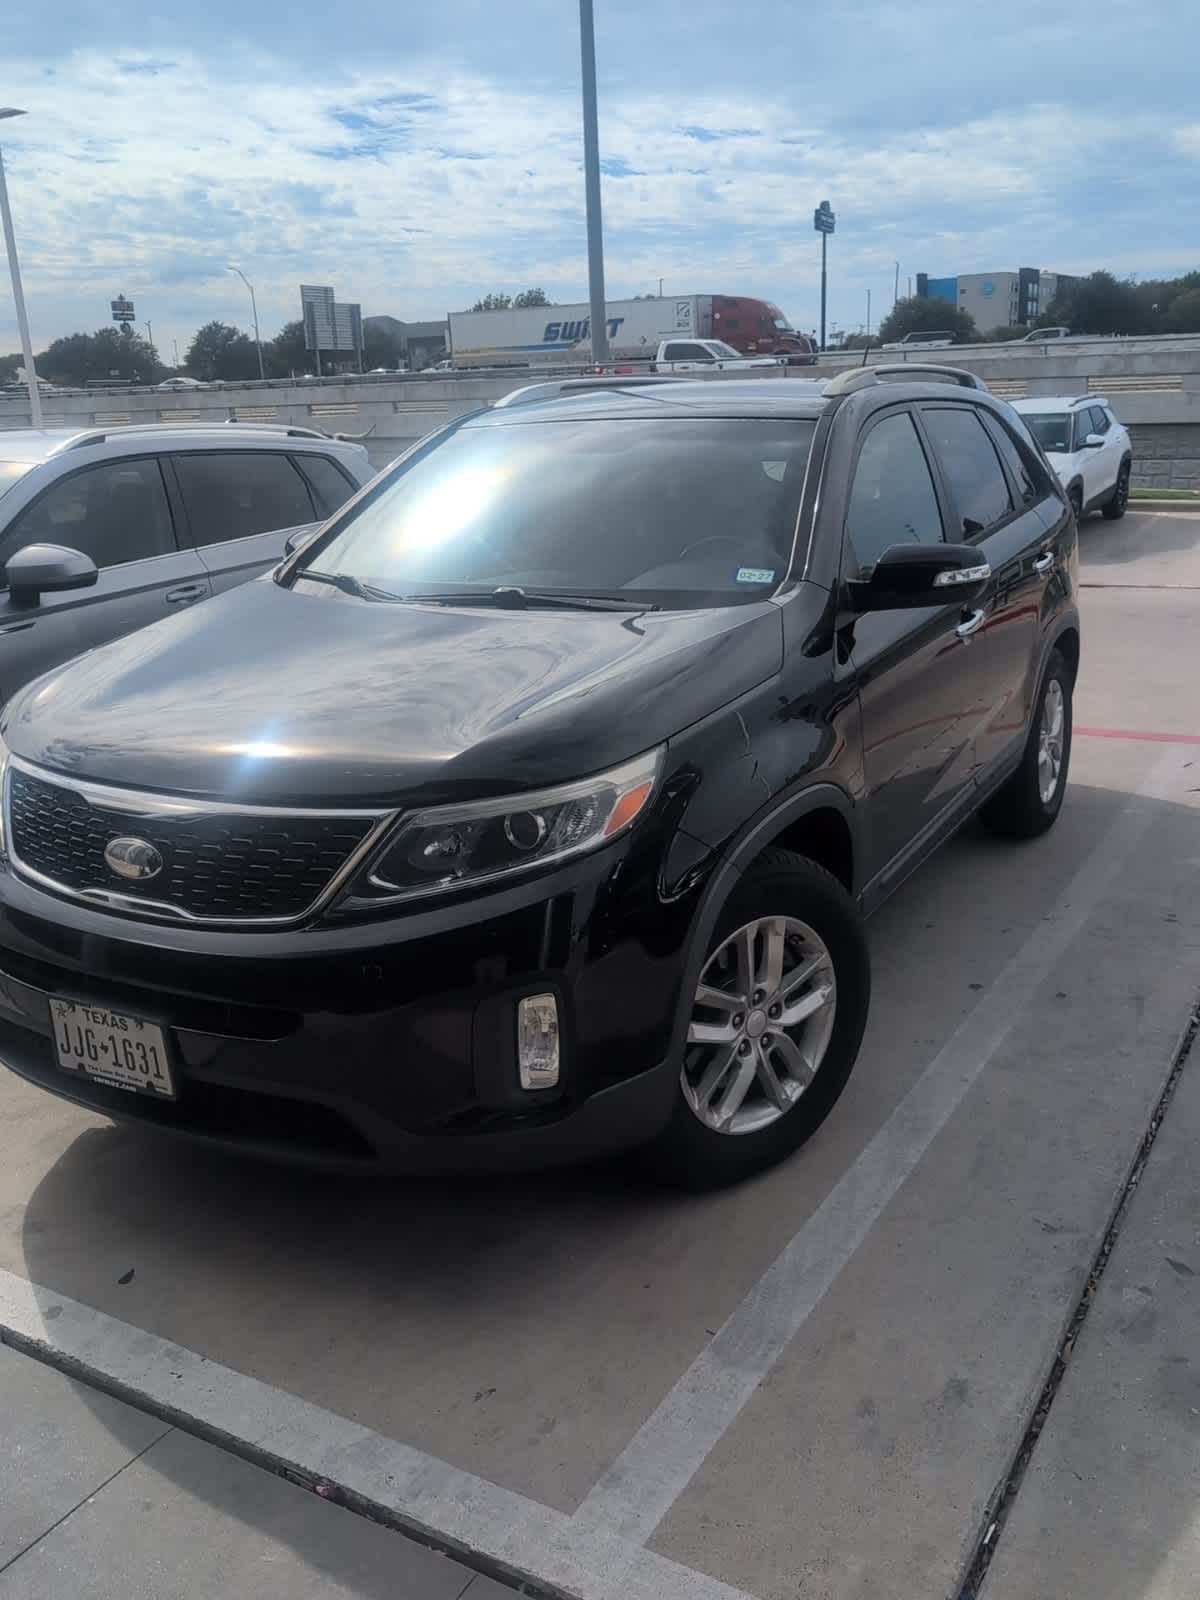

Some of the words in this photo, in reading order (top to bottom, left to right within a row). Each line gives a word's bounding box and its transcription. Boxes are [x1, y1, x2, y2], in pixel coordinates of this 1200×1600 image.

[543, 317, 625, 341] SWIT
[82, 1008, 128, 1032] TEXAS
[60, 1023, 99, 1061] JJG
[108, 1034, 164, 1079] 1631
